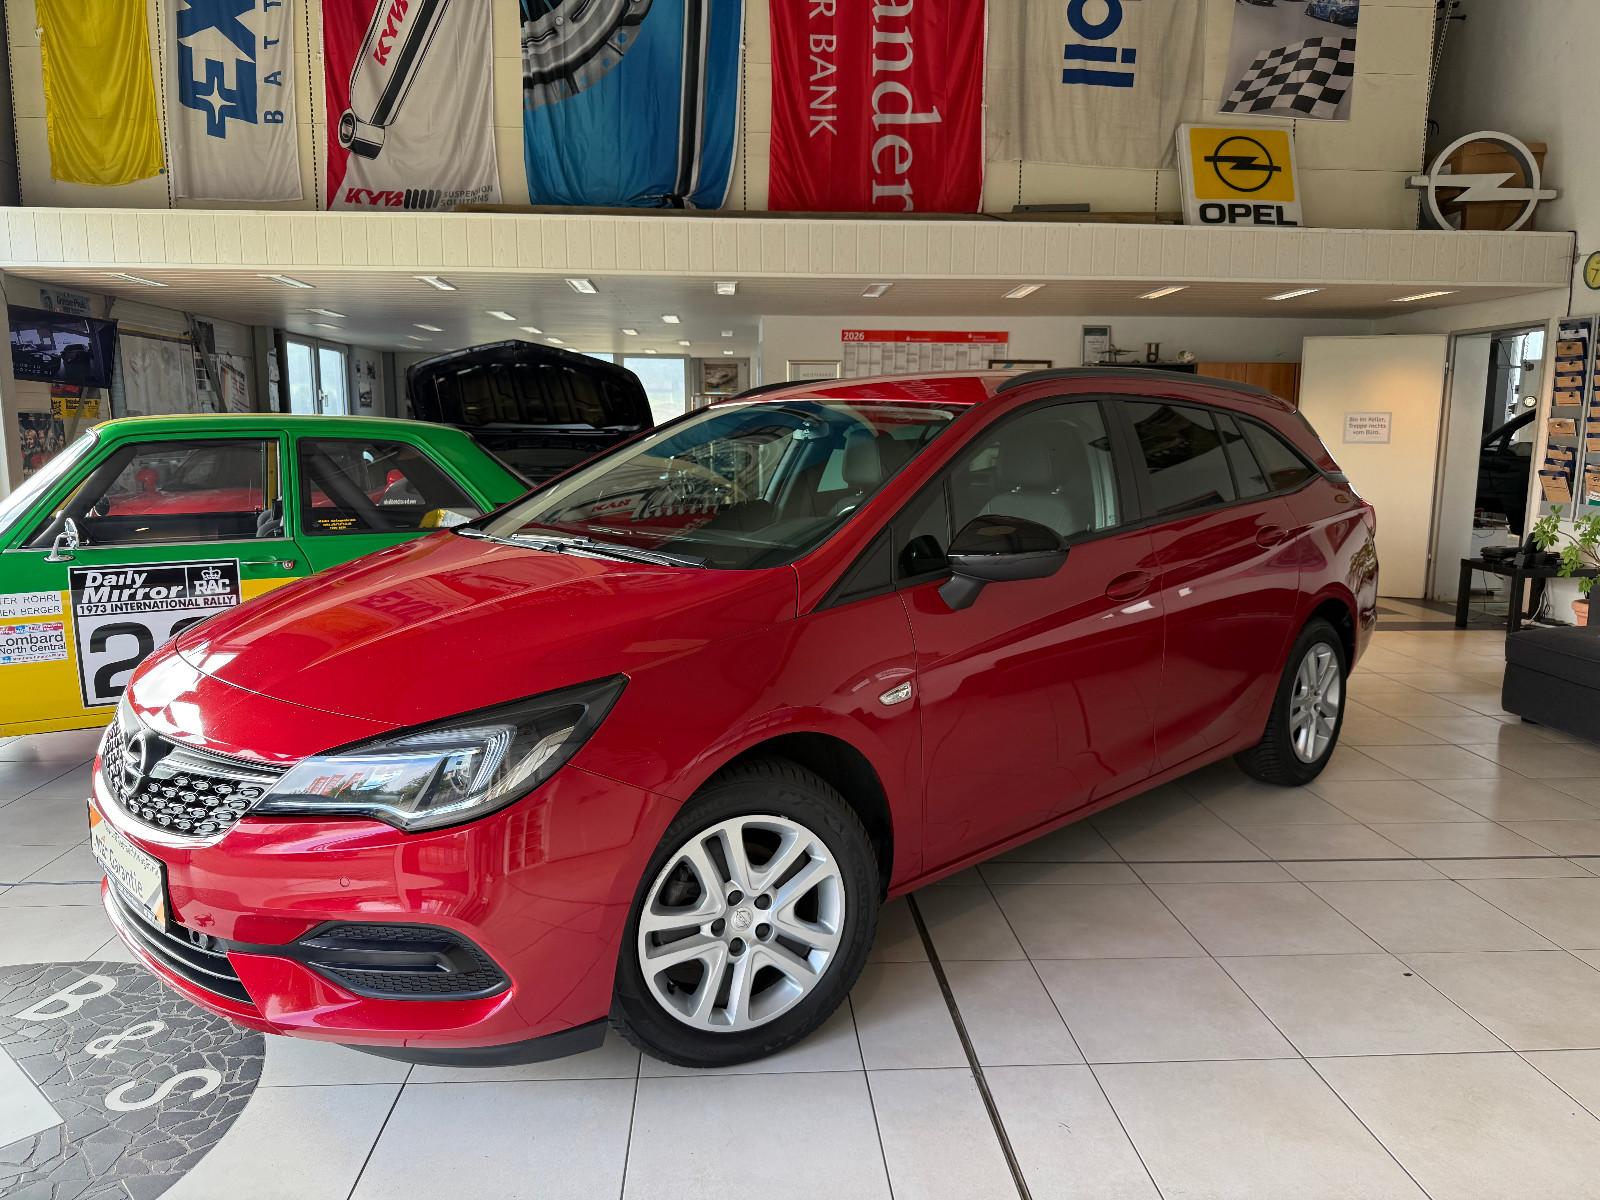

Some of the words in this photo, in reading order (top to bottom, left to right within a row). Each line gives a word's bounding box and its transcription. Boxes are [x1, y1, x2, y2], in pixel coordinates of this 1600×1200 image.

[809, 0, 837, 20] R
[809, 34, 838, 138] BANK
[344, 188, 405, 207] KYB
[1199, 203, 1298, 226] OPEL
[843, 331, 865, 342] 2026
[85, 570, 148, 590] Daily
[194, 578, 231, 596] RAC
[82, 584, 184, 604] Mirror
[0, 608, 16, 617] EN
[20, 605, 61, 616] BERGER
[79, 604, 107, 615] 1973
[110, 598, 201, 613] INTERNATIONAL
[203, 595, 235, 607] RALLY
[29, 642, 66, 653] Central
[14, 974, 117, 1022] B
[85, 1020, 166, 1059] &
[104, 1068, 222, 1112] S
